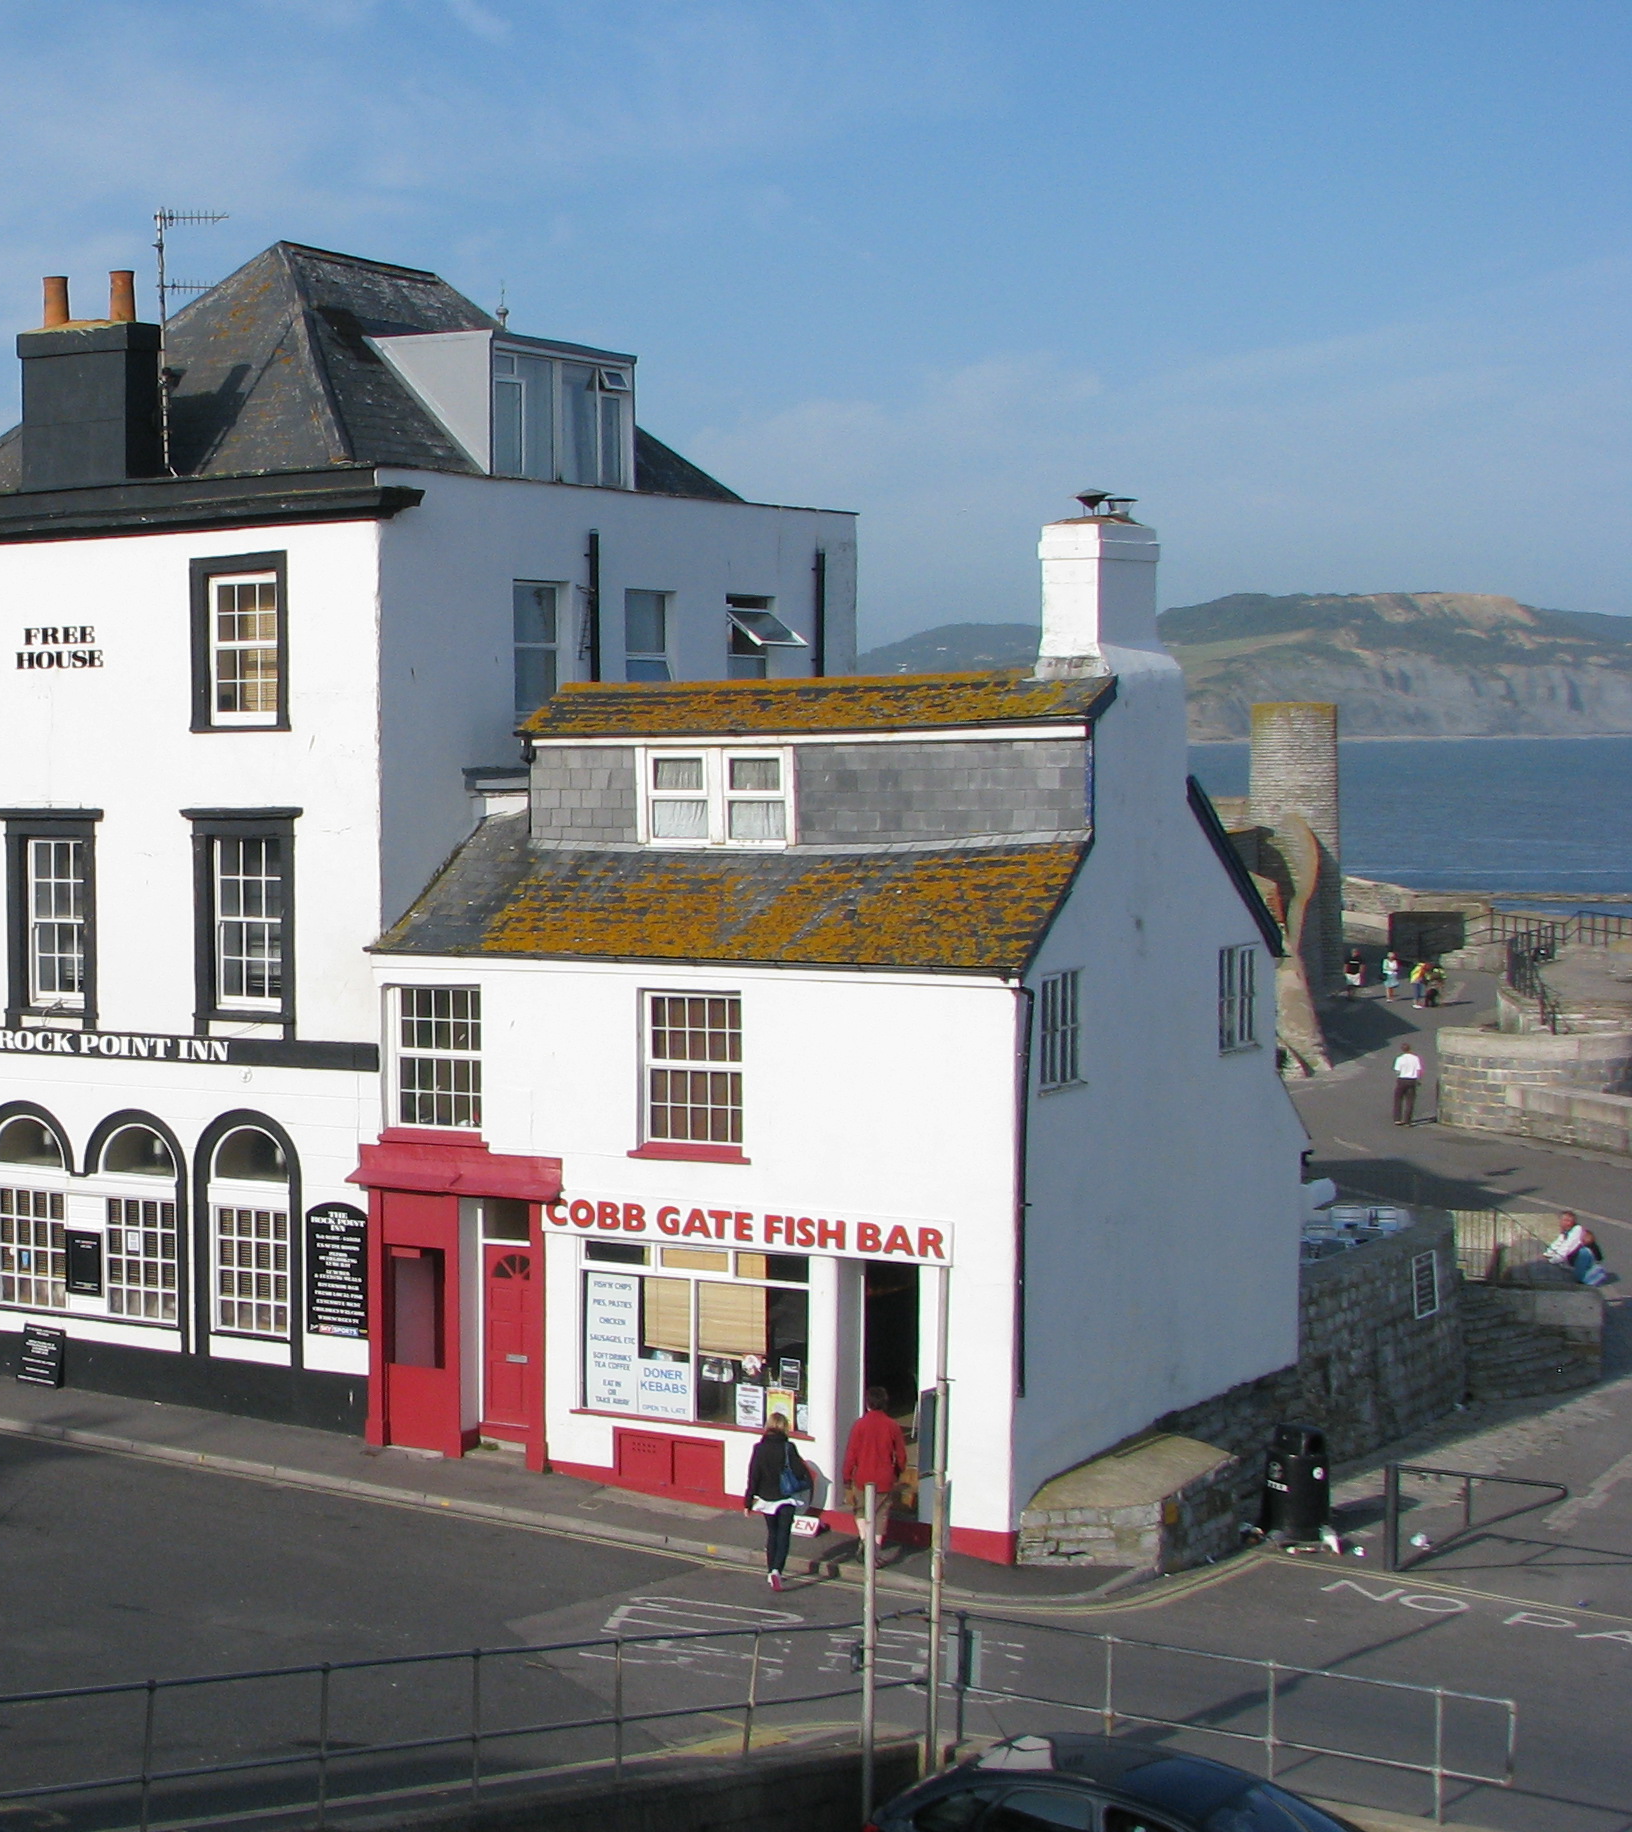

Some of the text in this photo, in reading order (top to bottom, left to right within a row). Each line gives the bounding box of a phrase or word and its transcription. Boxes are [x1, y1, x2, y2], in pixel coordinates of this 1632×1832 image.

[24, 626, 95, 645] FREE
[16, 650, 103, 670] HOUSE
[79, 1034, 171, 1058] POINT
[177, 1039, 230, 1062] INN
[545, 1199, 946, 1259] COBB GATE FISH BAR
[615, 1282, 632, 1290] CHIPS
[609, 1300, 632, 1308] PASTIES
[599, 1317, 626, 1325] CHICKEN
[624, 1337, 635, 1345] ETC
[593, 1352, 632, 1362] SOFT DRINKS
[608, 1362, 630, 1371] COFFEE
[644, 1368, 682, 1380] DONER
[640, 1380, 687, 1394] KEBABS
[1321, 1579, 1470, 1612] NO
